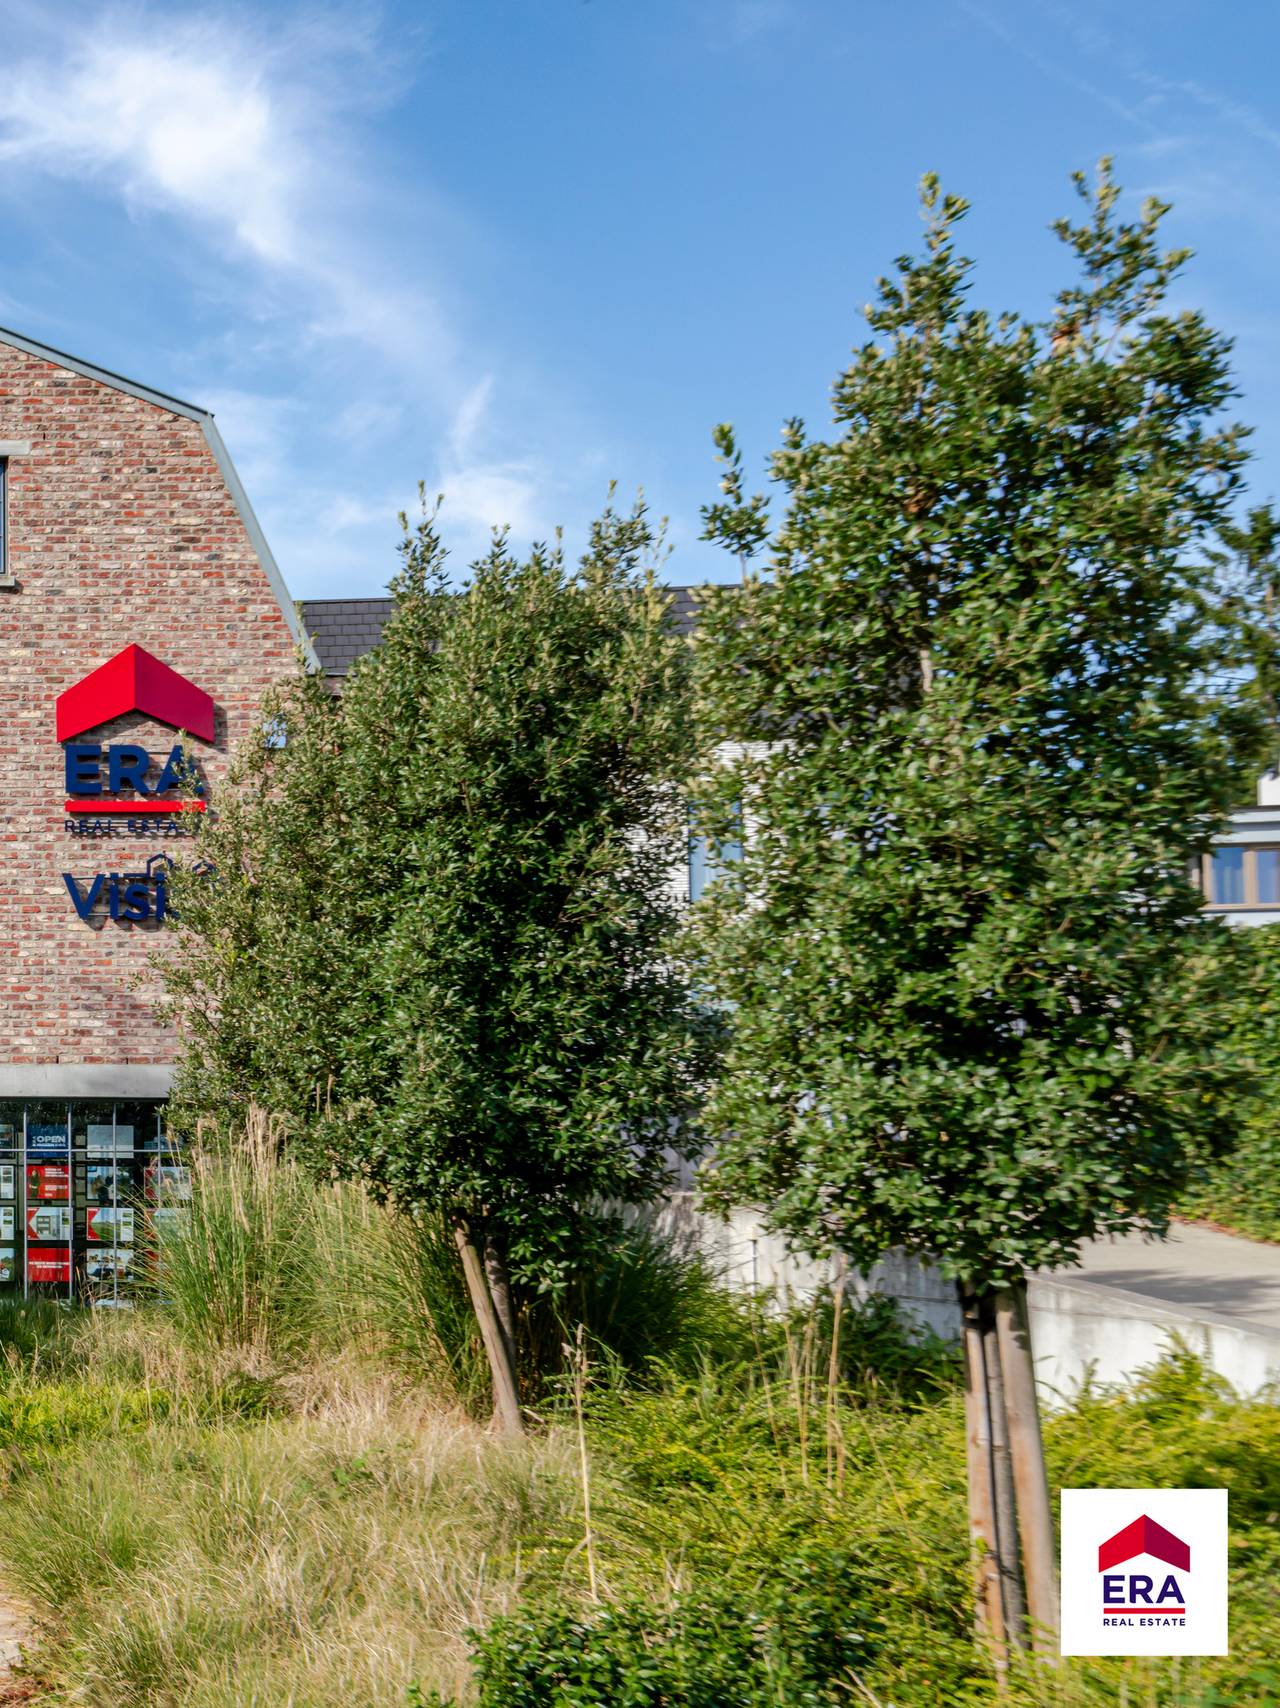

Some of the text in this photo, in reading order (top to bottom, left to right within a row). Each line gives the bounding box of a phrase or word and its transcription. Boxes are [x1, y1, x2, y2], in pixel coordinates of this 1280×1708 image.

[65, 744, 205, 795] ERA
[64, 819, 116, 833] REAL
[36, 1135, 66, 1143] OPEN
